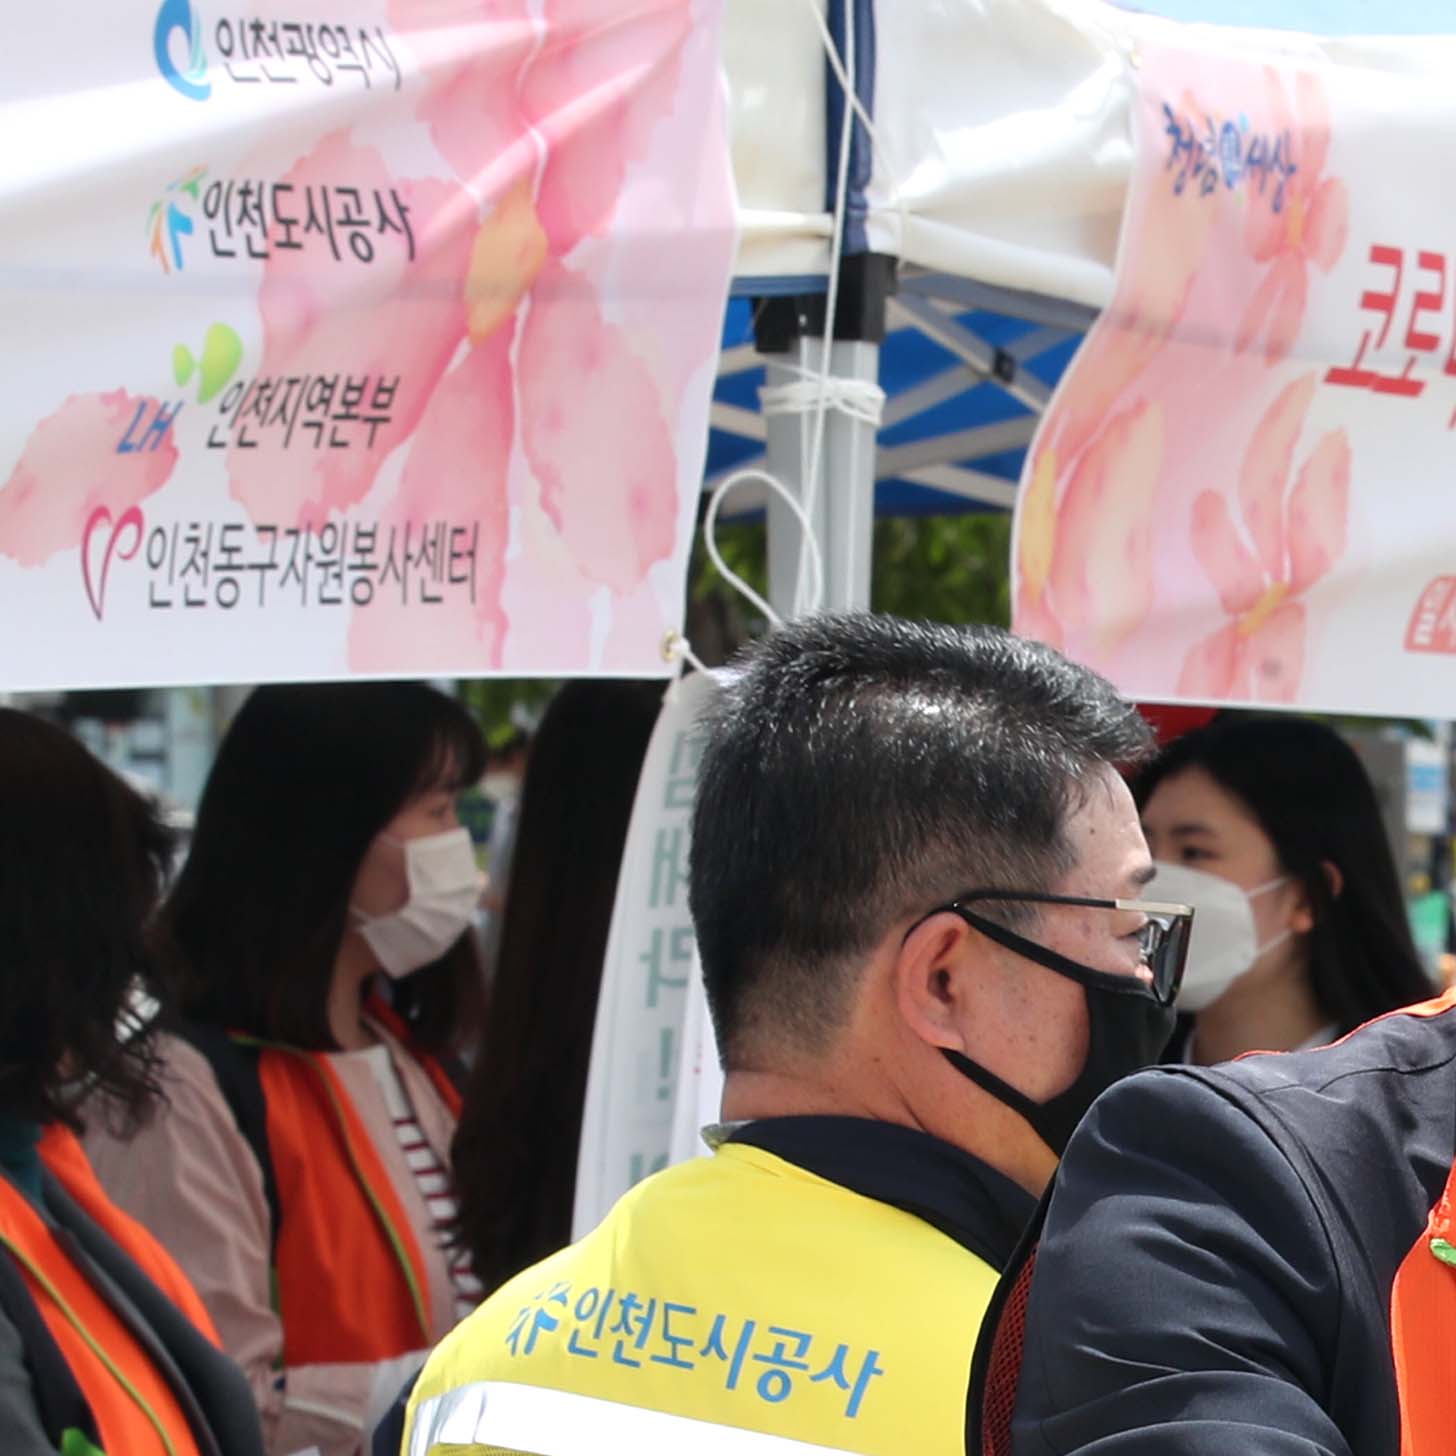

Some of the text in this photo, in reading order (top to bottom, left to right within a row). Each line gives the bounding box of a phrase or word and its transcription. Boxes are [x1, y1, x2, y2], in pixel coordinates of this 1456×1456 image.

[214, 15, 401, 91] 인천광역시
[202, 179, 416, 264] 인천도시공사
[116, 401, 184, 454] LH
[206, 374, 402, 451] 인천지역본부
[146, 519, 480, 610] 인천동구자원봉사센터
[567, 1286, 884, 1419] 인천도시공사
